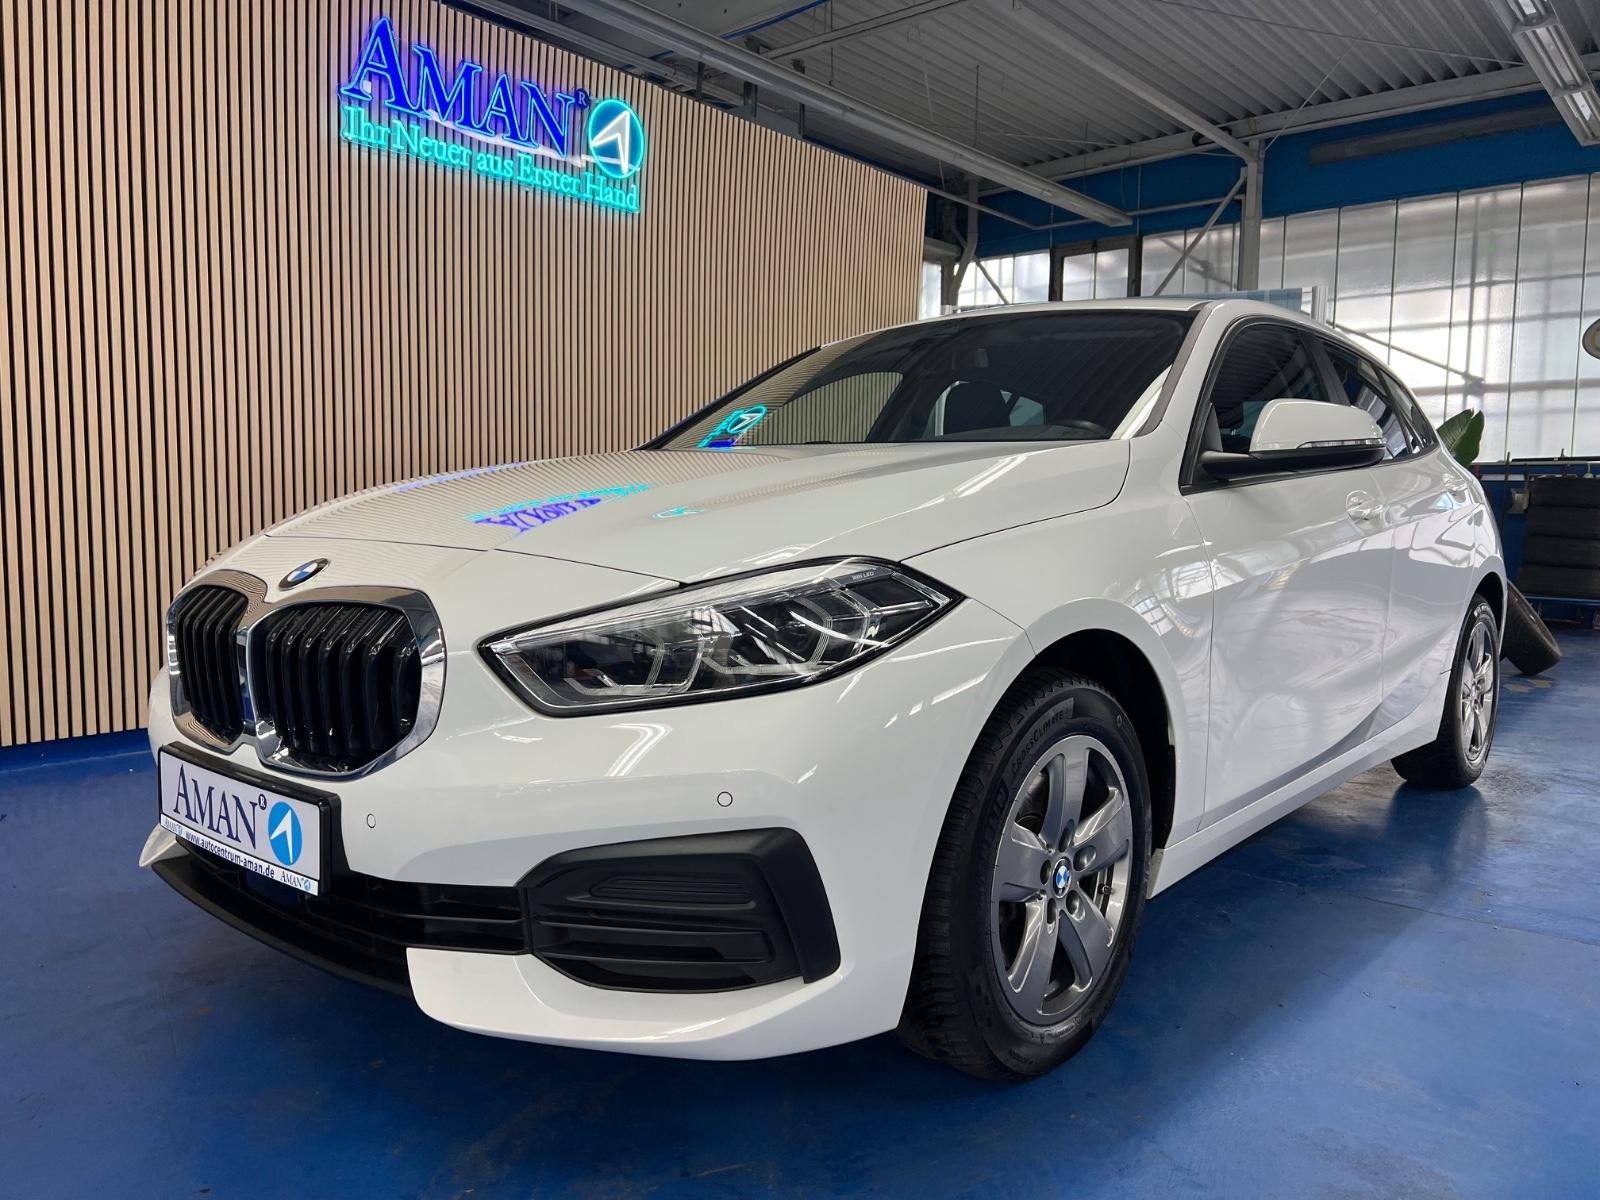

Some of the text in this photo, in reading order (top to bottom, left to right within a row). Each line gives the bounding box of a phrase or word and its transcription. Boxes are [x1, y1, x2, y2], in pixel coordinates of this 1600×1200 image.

[342, 105, 640, 213] Ihr Neuer aus Erster Hand
[185, 831, 275, 879] www.autocentrum-aman.de
